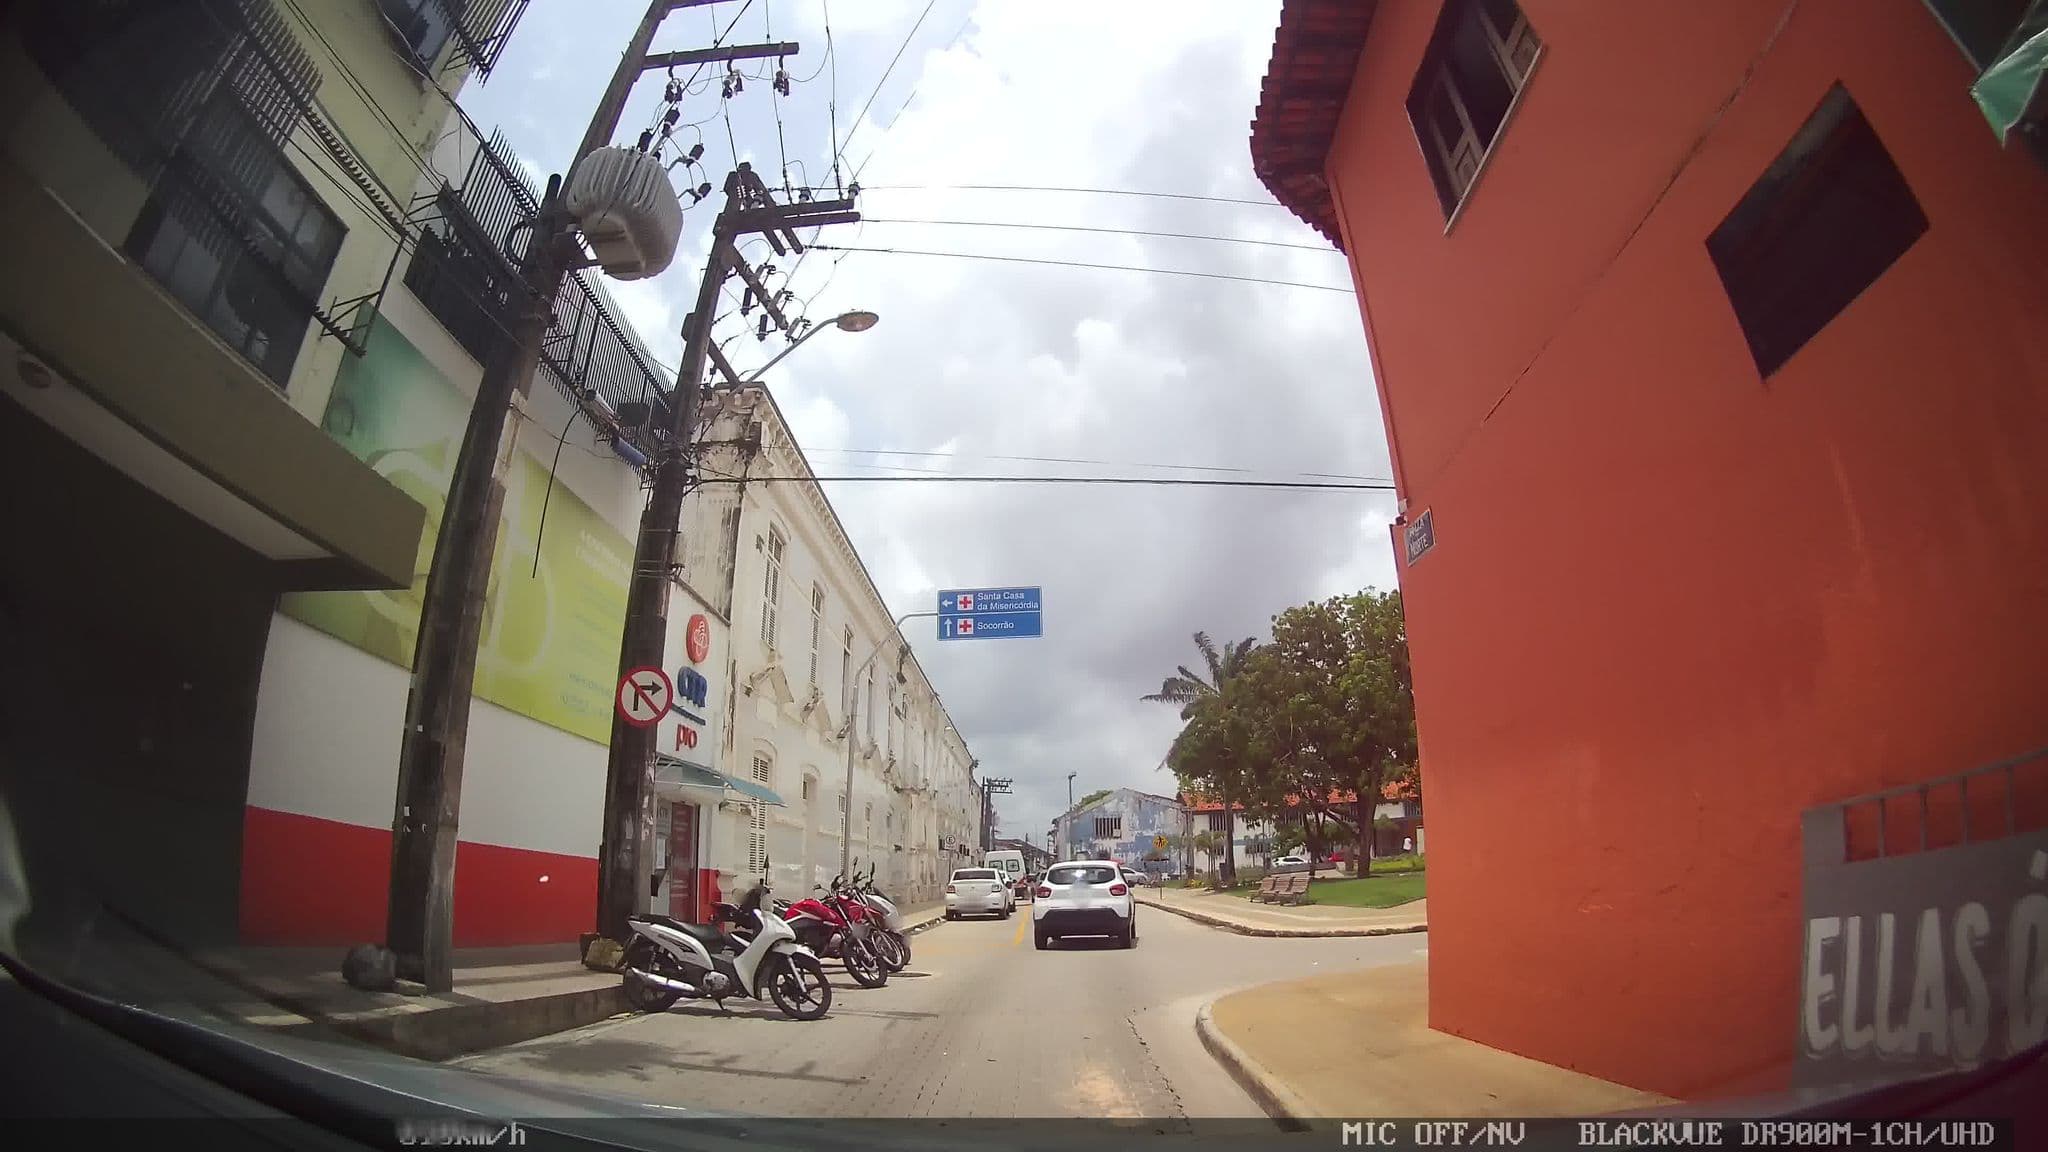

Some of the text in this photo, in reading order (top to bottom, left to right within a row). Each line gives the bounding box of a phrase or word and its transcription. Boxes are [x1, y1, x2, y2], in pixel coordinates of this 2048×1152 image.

[977, 591, 1025, 601] Santa Casa
[977, 601, 1039, 611] da Misericórdia
[977, 621, 1015, 630] Socorrão
[1804, 900, 1992, 1066] ELLAS
